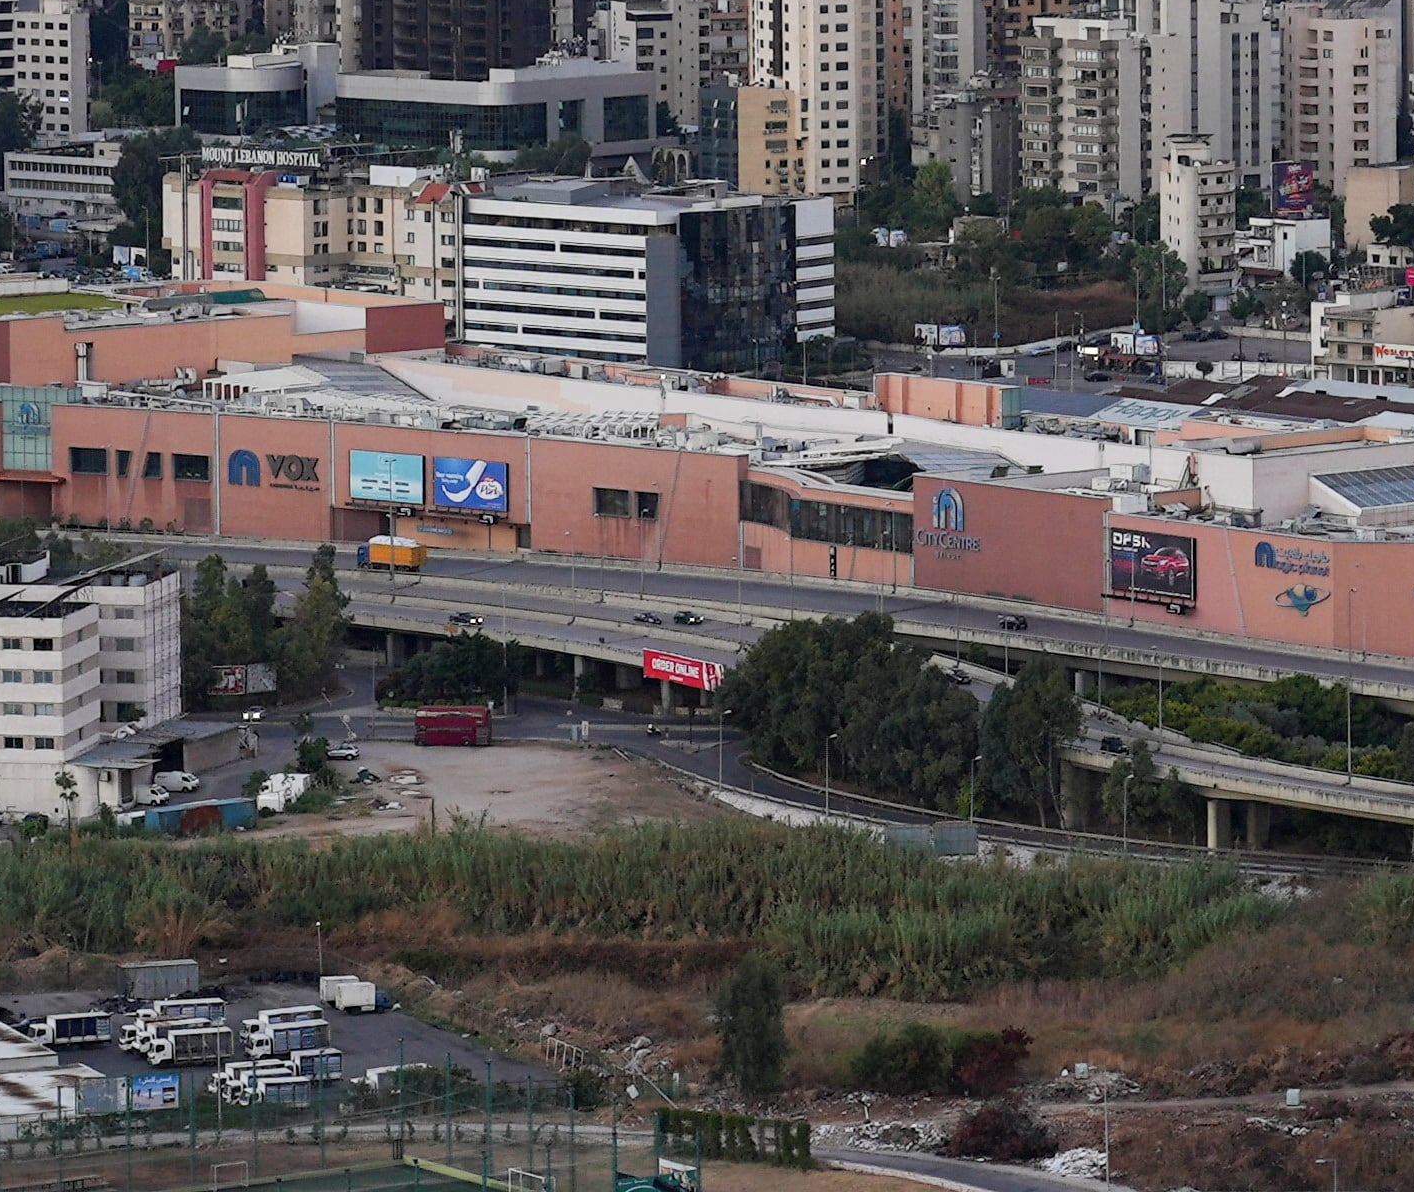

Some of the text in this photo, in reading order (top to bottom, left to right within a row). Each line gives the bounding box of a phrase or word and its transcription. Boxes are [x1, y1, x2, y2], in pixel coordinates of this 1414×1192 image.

[201, 147, 321, 167] MOUNT LEBANON HOSPITAL
[266, 454, 319, 482] VOX
[651, 658, 675, 673] ORDER
[675, 662, 700, 679] ONLINE
